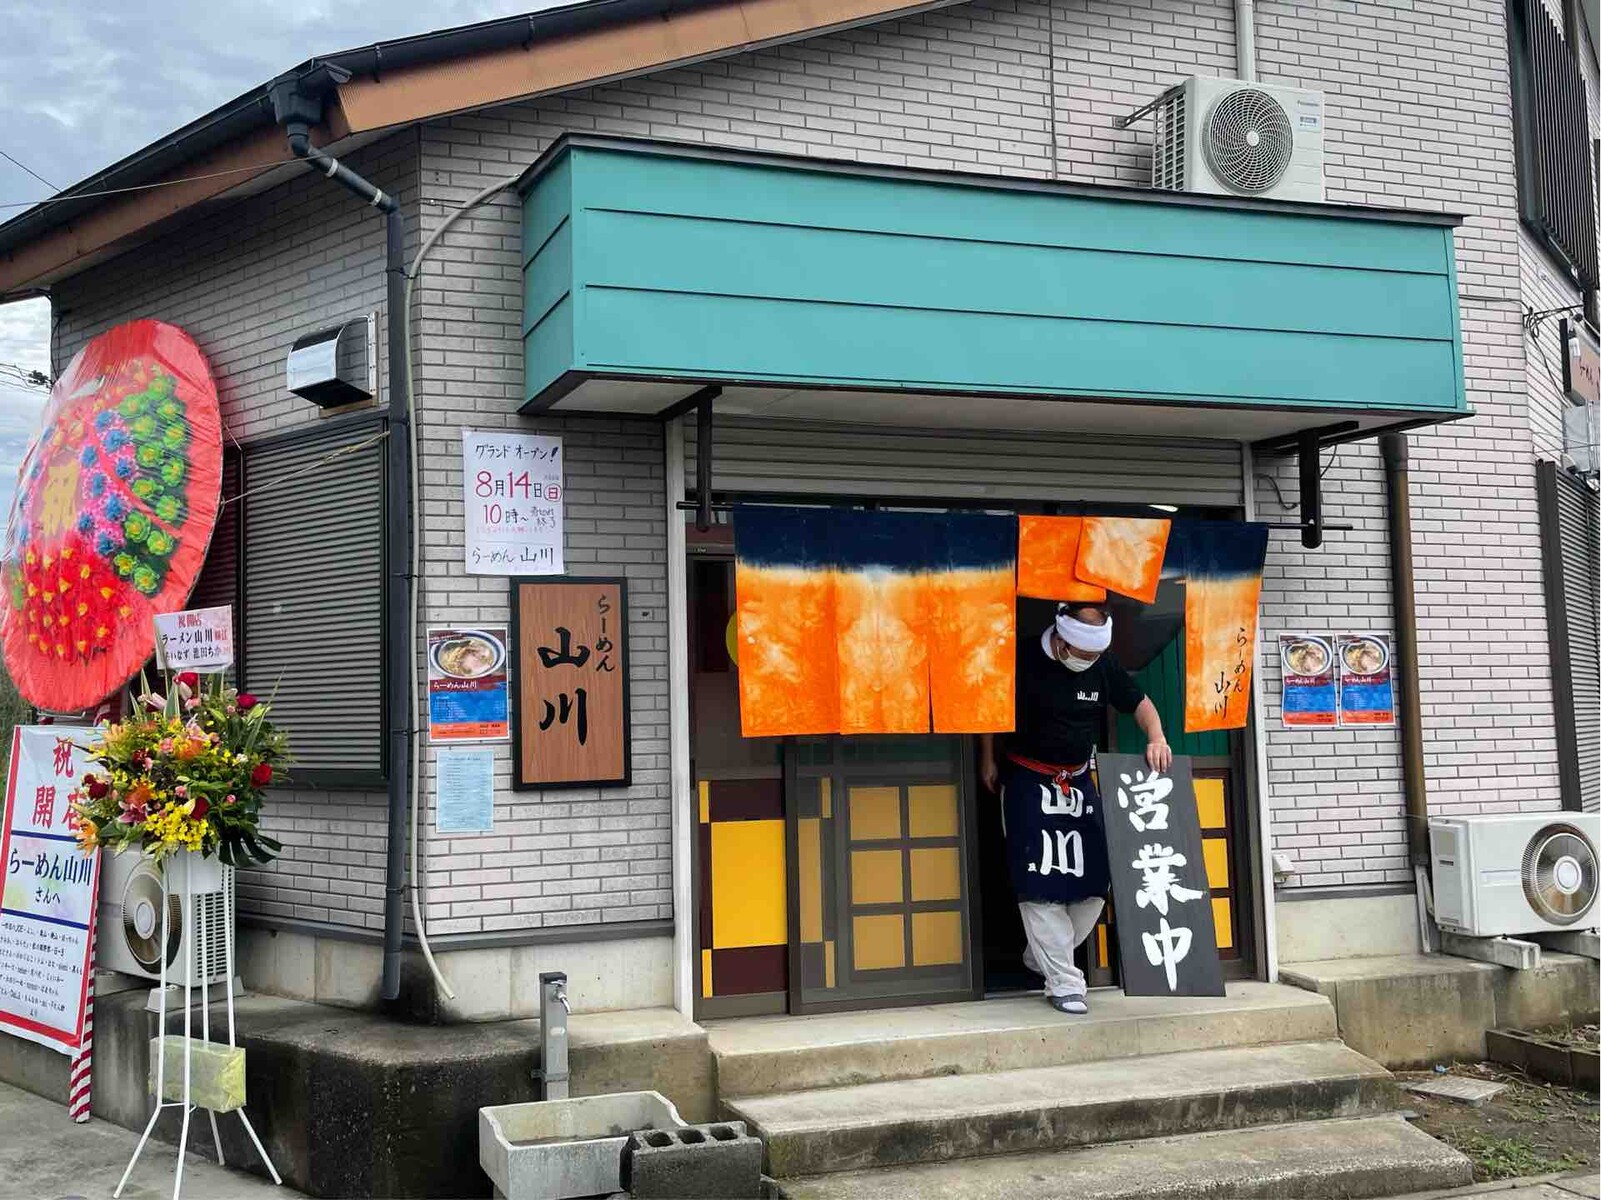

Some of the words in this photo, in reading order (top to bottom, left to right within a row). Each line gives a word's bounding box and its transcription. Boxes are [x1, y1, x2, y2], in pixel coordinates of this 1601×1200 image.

[475, 444, 510, 460] グランド
[520, 546, 554, 566] 山川
[595, 594, 616, 672] らーめん
[1234, 627, 1248, 693] らーめん
[537, 626, 591, 746] 山川
[1214, 671, 1231, 719] 山川
[52, 738, 75, 778] 祝
[1039, 783, 1085, 878] 山川
[9, 847, 93, 887] らーめん山川
[1117, 768, 1208, 993] 営業中
[35, 886, 61, 905] さんへ
